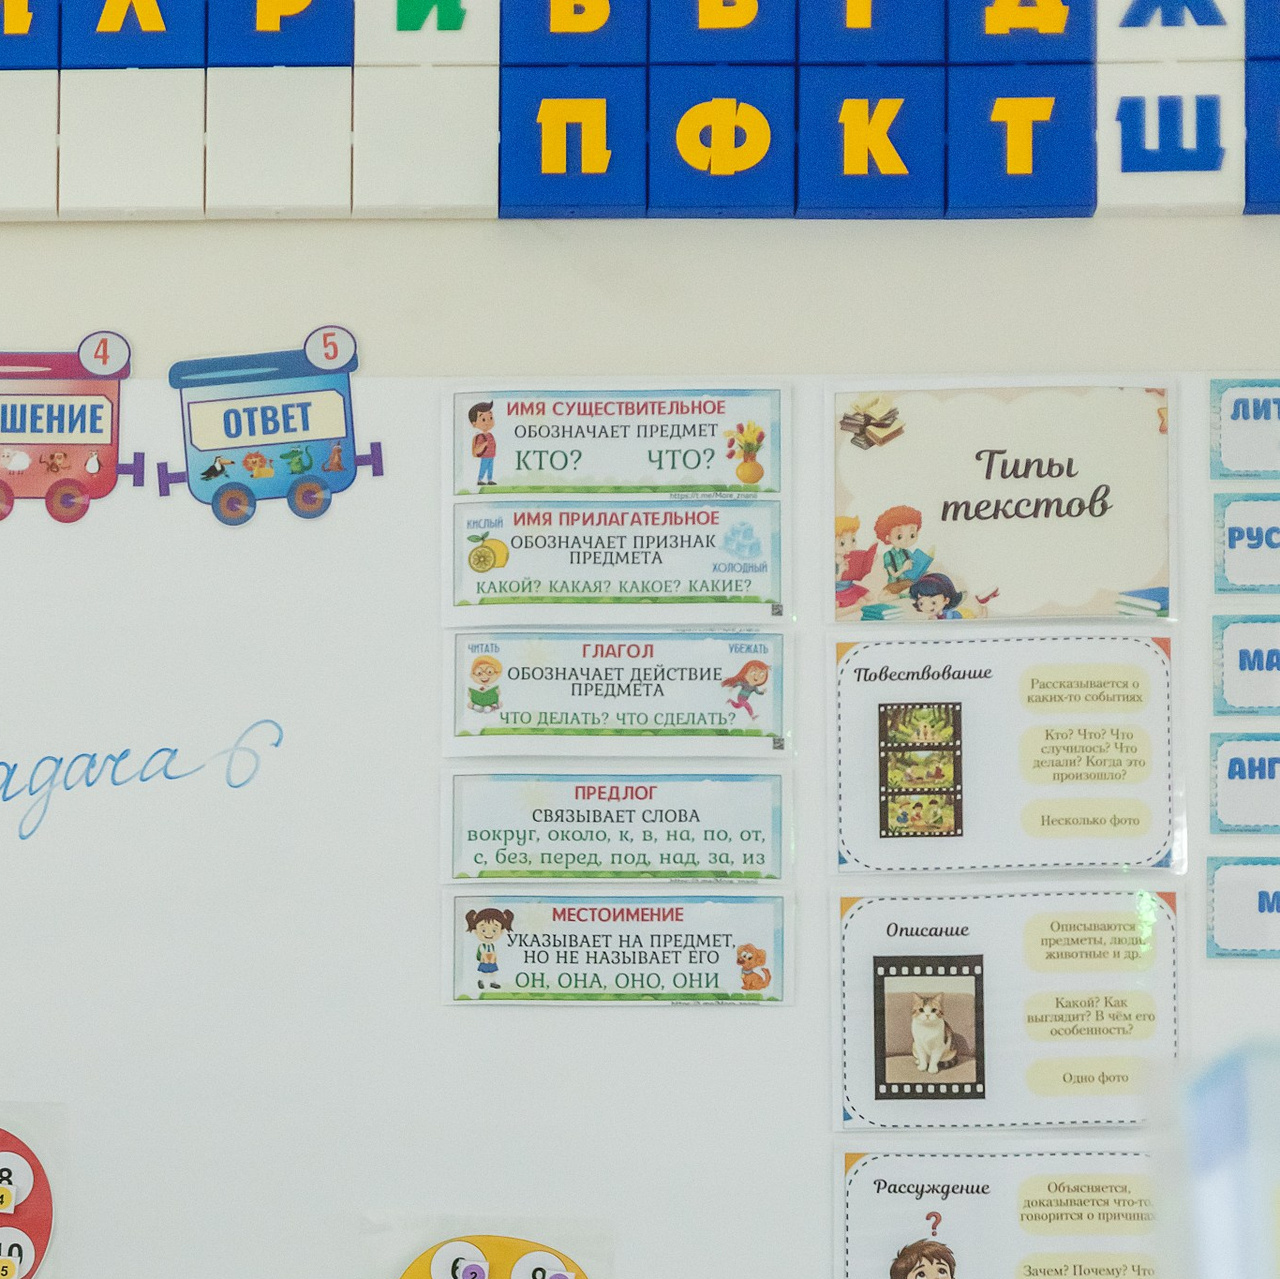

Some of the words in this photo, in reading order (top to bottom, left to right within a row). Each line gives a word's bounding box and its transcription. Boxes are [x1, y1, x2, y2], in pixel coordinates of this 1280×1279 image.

[536, 98, 611, 174] П
[675, 97, 771, 175] Ф
[838, 98, 910, 175] К
[990, 97, 1055, 175] Т
[1115, 95, 1226, 172] Ш
[93, 338, 110, 365] 4
[322, 332, 338, 361] 5
[507, 401, 546, 416] ИМЯ
[552, 400, 726, 417] СУЩЕСТВИТЕЛЬНОЕ
[223, 402, 313, 438] ОТВЕТ
[514, 424, 630, 439] ОБОЗНАЧАЕТ
[637, 423, 719, 439] ПРЕДМЕТ
[515, 450, 582, 470] КТО?
[648, 449, 715, 470] ЧТО?
[975, 449, 1079, 480] Типы
[941, 484, 1114, 522] текстов
[513, 512, 552, 527] ИМЯ
[559, 510, 720, 527] ПРИЛАГАТЕЛЬНОЕ
[510, 535, 627, 549] ОБОЗНАЧАЕТ
[633, 534, 716, 548] ПРИЗНАК
[570, 550, 663, 566] ПРЕДМЕТА
[476, 577, 542, 594] КАКОЙ?
[548, 580, 611, 594] КАКАЯ?
[619, 579, 681, 593] КАКОЕ?
[688, 578, 752, 593] КАКИЕ?
[582, 644, 654, 659] ГЛАГОЛ
[507, 666, 624, 681] ОБОЗНАЧАЕТ
[630, 664, 723, 682] ДЕЙСТВИЕ
[853, 664, 994, 683] Повествование
[571, 682, 664, 698] ПРЕДМЕТА
[499, 712, 532, 725] ЧТО
[537, 711, 609, 727] ДЕЛАТЬ?
[616, 711, 649, 725] ЧТО
[654, 711, 736, 727] СДЕЛАТЬ?
[1045, 729, 1074, 740] Кто?
[1077, 728, 1107, 740] Что?
[1110, 729, 1134, 740] Что
[1040, 742, 1111, 756] случилось?
[1114, 742, 1138, 754] Что
[1033, 756, 1082, 769] делали?
[1085, 756, 1123, 769] Когда
[1126, 758, 1146, 768] это
[1053, 769, 1127, 783] произошло?
[574, 785, 658, 802] ПРЕДЛОГ
[532, 808, 636, 823] СВЯЗЫВАЕТ
[642, 808, 701, 823] СЛОВА
[1040, 815, 1107, 827] Несколько
[1109, 814, 1140, 829] фото
[467, 828, 540, 847] вокруг,
[548, 828, 611, 843] около,
[666, 828, 695, 843] на,
[703, 828, 732, 843] по,
[740, 828, 766, 843] от,
[495, 847, 532, 866] без,
[659, 850, 700, 868] над,
[708, 851, 735, 865] за,
[743, 851, 765, 864] из
[552, 907, 684, 922] МЕСТОИМЕНИЕ
[886, 922, 970, 938] Описание
[507, 934, 612, 948] УКАЗЫВАЕТ
[619, 934, 643, 947] НА
[650, 934, 736, 950] ПРЕДМЕТ,
[524, 951, 549, 964] НО
[556, 951, 579, 964] НЕ
[585, 951, 682, 965] НАЗЫВАЕТ
[688, 950, 720, 964] ЕГО
[515, 973, 550, 990] ОН,
[558, 973, 607, 990] ОНА,
[615, 973, 665, 990] ОНО,
[672, 973, 719, 989] ОНИ
[1054, 997, 1101, 1009] Какой?
[1103, 996, 1128, 1008] Как
[1027, 1010, 1092, 1024] выглядит?
[1050, 1024, 1134, 1036] особенность?
[1062, 1073, 1095, 1086] Одно
[1098, 1072, 1129, 1087] фото
[873, 1179, 991, 1200] Рассуждение
[1, 1265, 8, 1277] 5
[1023, 1264, 1070, 1277] Зачем?
[1072, 1264, 1128, 1279] Почему?
[1131, 1265, 1155, 1277] Что
